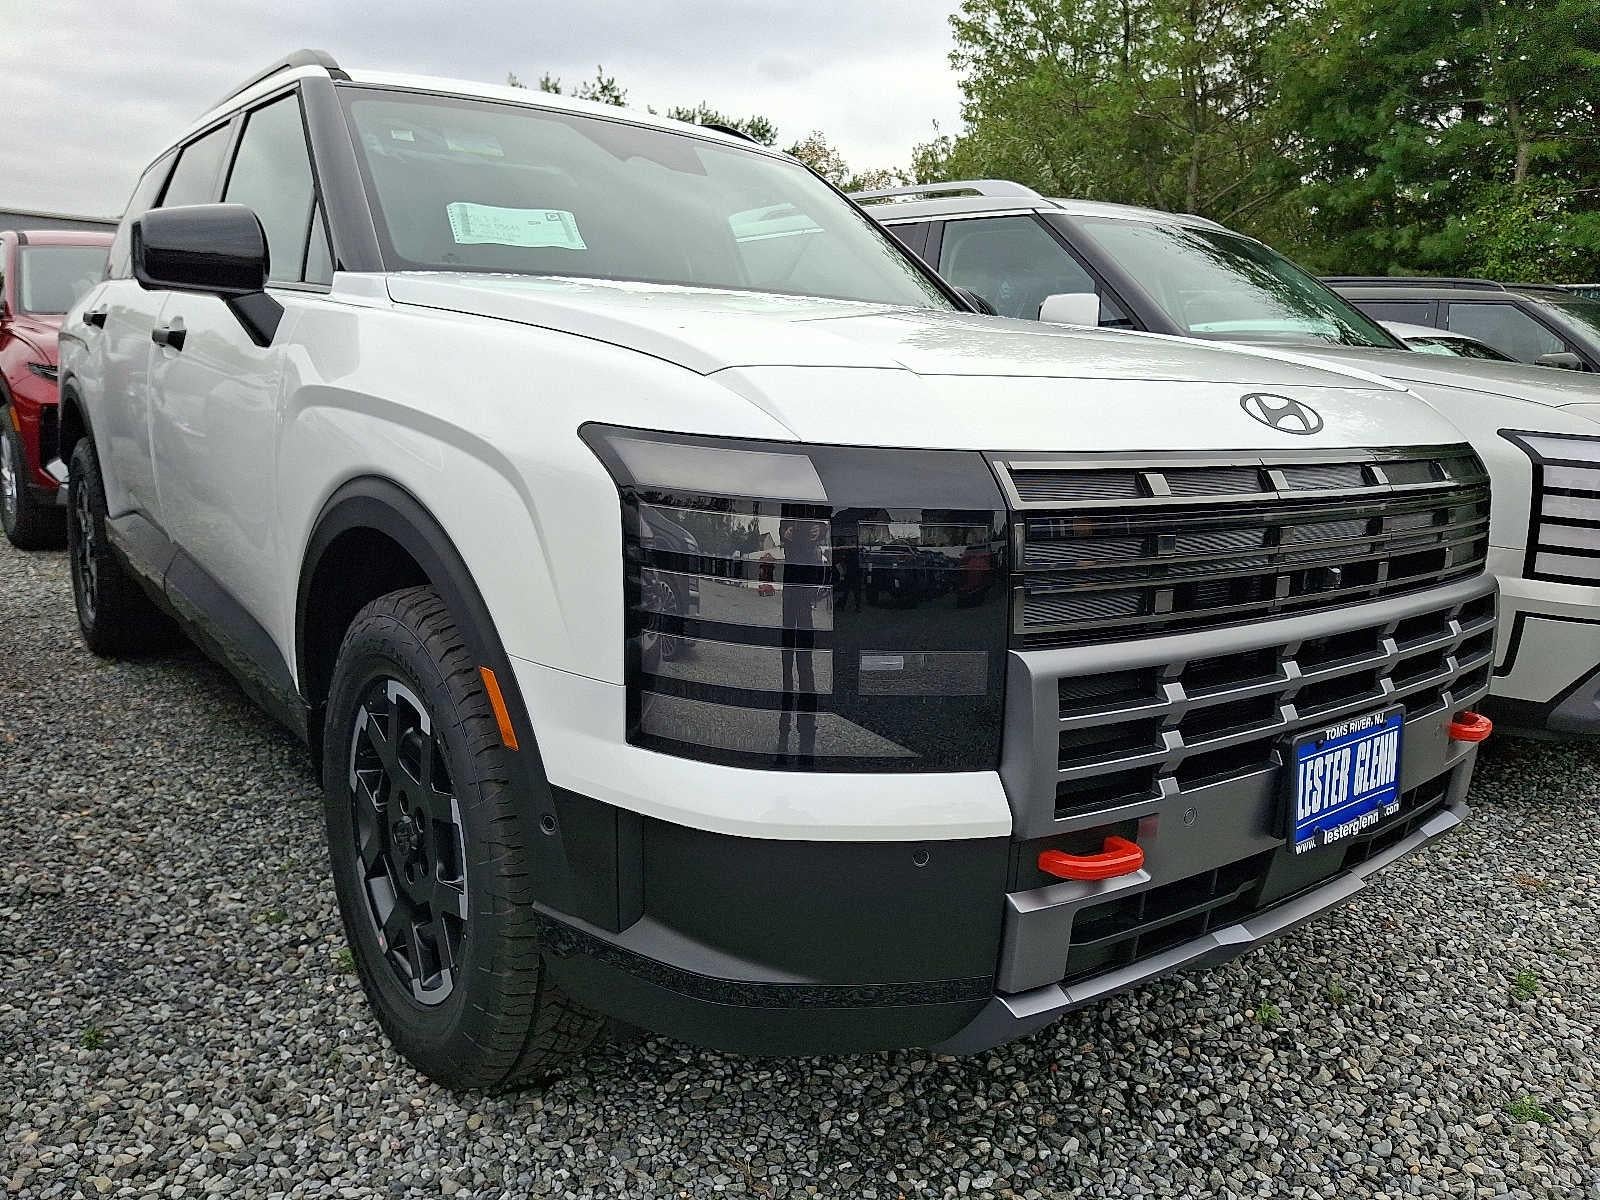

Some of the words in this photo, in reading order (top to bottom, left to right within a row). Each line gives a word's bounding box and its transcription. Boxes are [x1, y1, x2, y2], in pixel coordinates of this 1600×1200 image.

[1325, 724, 1348, 741] TOMS
[1349, 717, 1374, 733] RIVER,
[1297, 748, 1351, 821] LESTER
[1354, 730, 1399, 796] GLENN
[1323, 811, 1379, 845] lesterglenn
